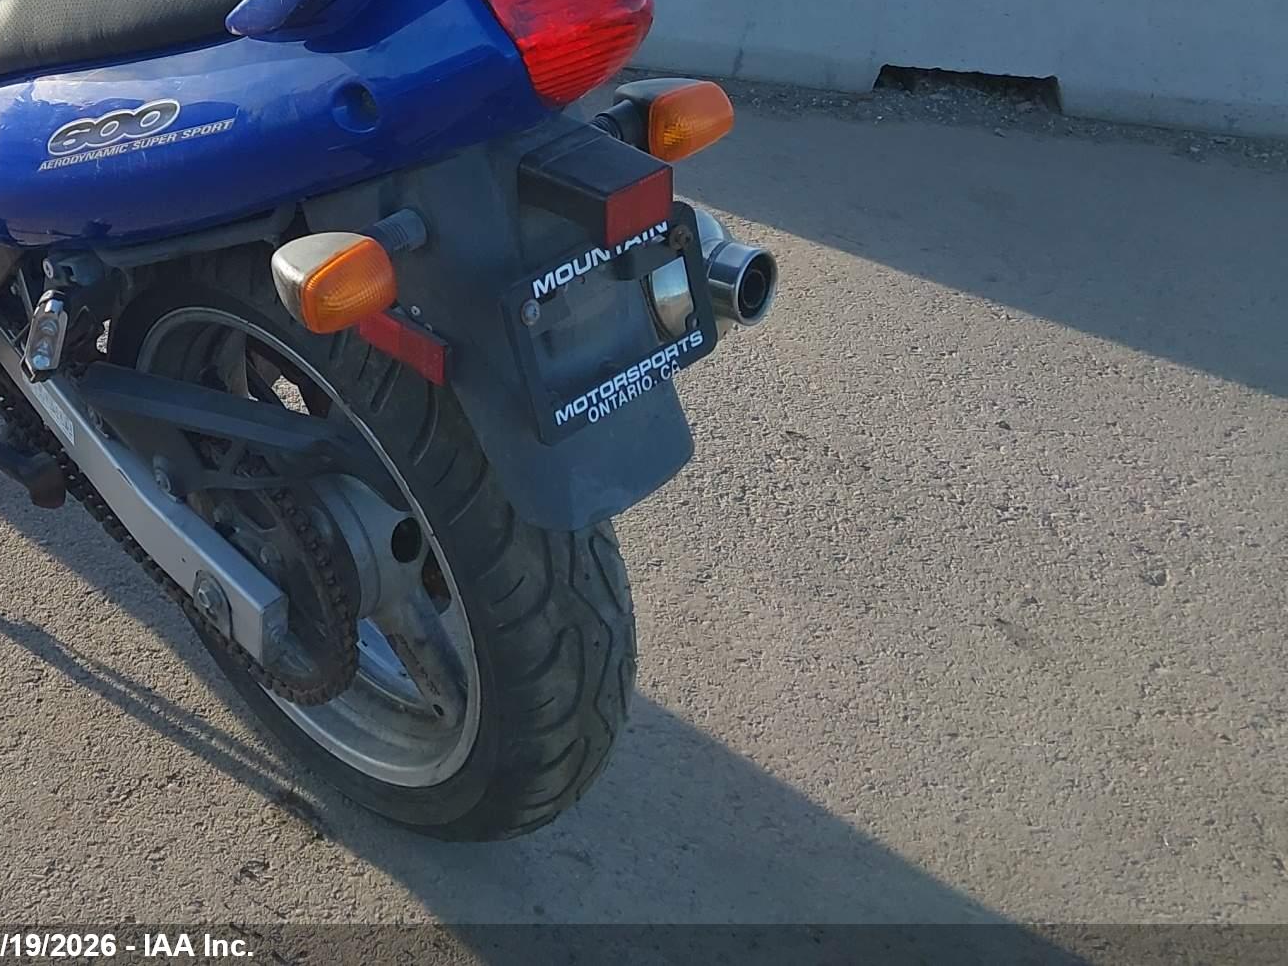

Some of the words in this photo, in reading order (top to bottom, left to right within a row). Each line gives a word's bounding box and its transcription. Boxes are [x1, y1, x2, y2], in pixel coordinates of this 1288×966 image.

[38, 143, 130, 171] AERODYNAMIC
[131, 133, 178, 151] SUPER
[180, 120, 235, 140] SPORT
[48, 98, 181, 156] 600
[555, 330, 704, 426] MOTORSPORTS
[661, 360, 681, 379] CA
